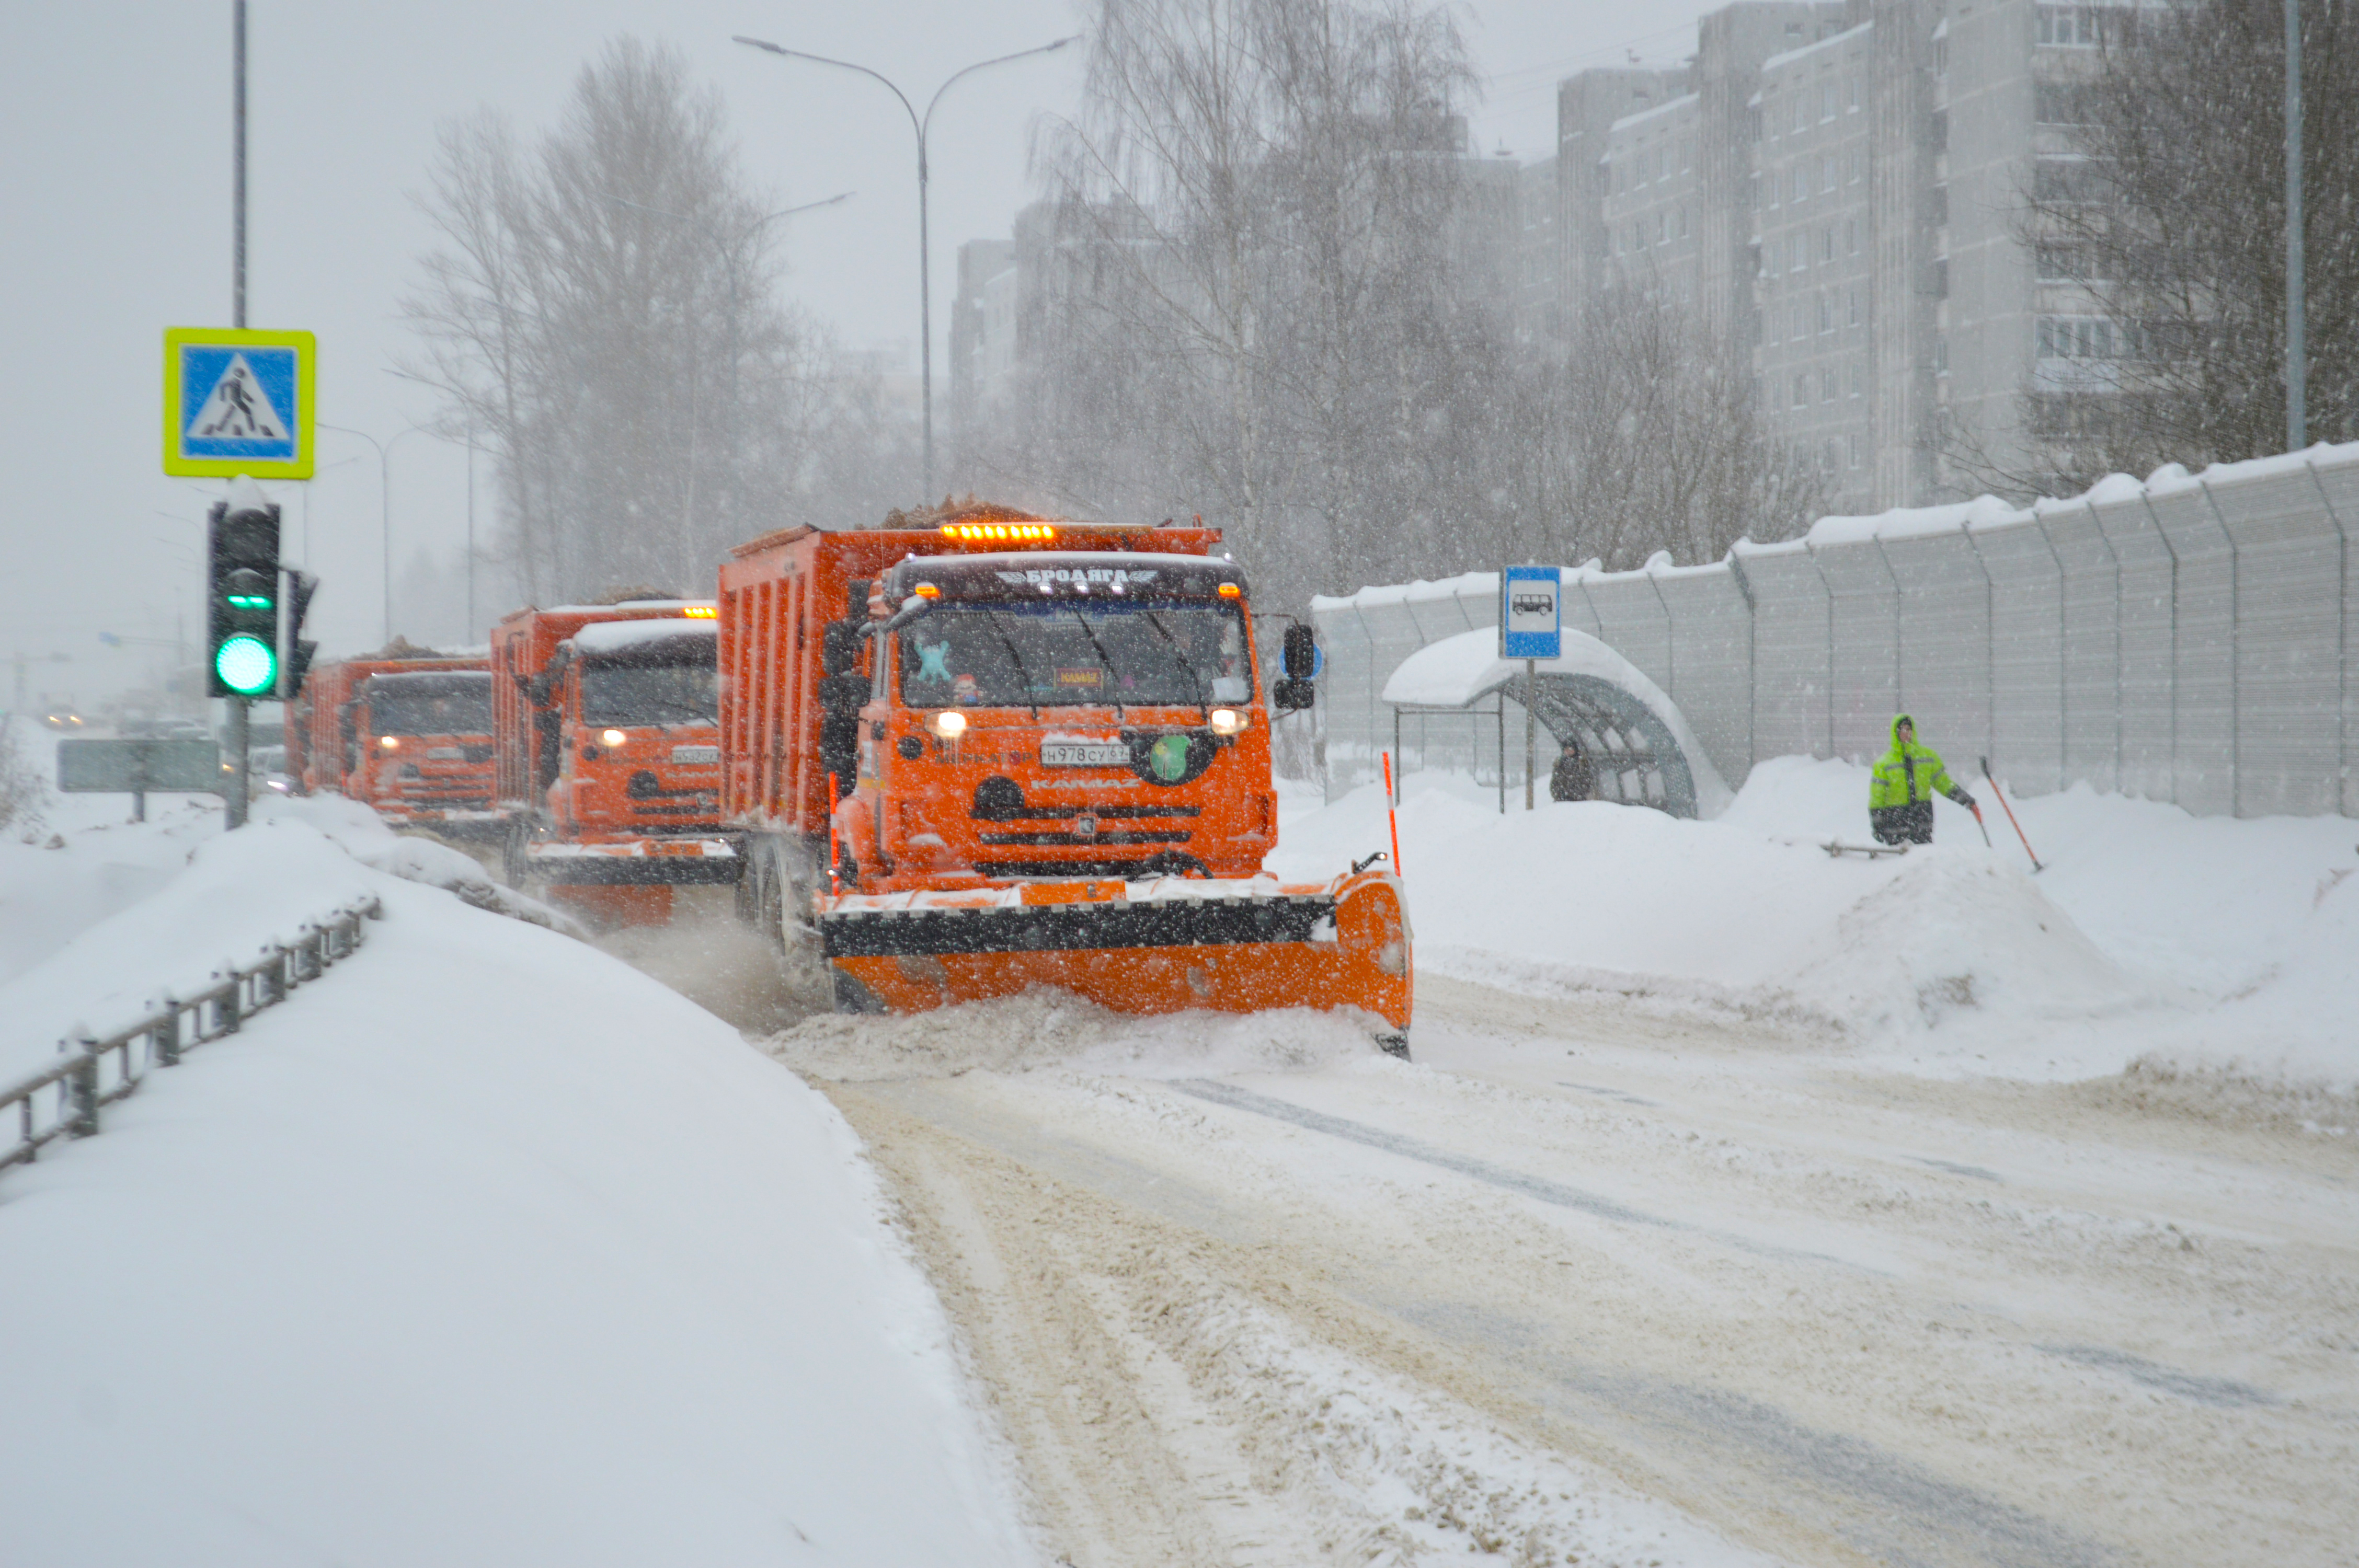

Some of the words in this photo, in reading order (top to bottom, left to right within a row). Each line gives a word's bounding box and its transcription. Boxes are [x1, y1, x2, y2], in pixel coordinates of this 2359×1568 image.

[1025, 569, 1129, 582] БРОДЯГА
[1061, 672, 1097, 683] KAMAZ
[1110, 746, 1124, 757] 69
[1031, 779, 1140, 789] KAMAZ
